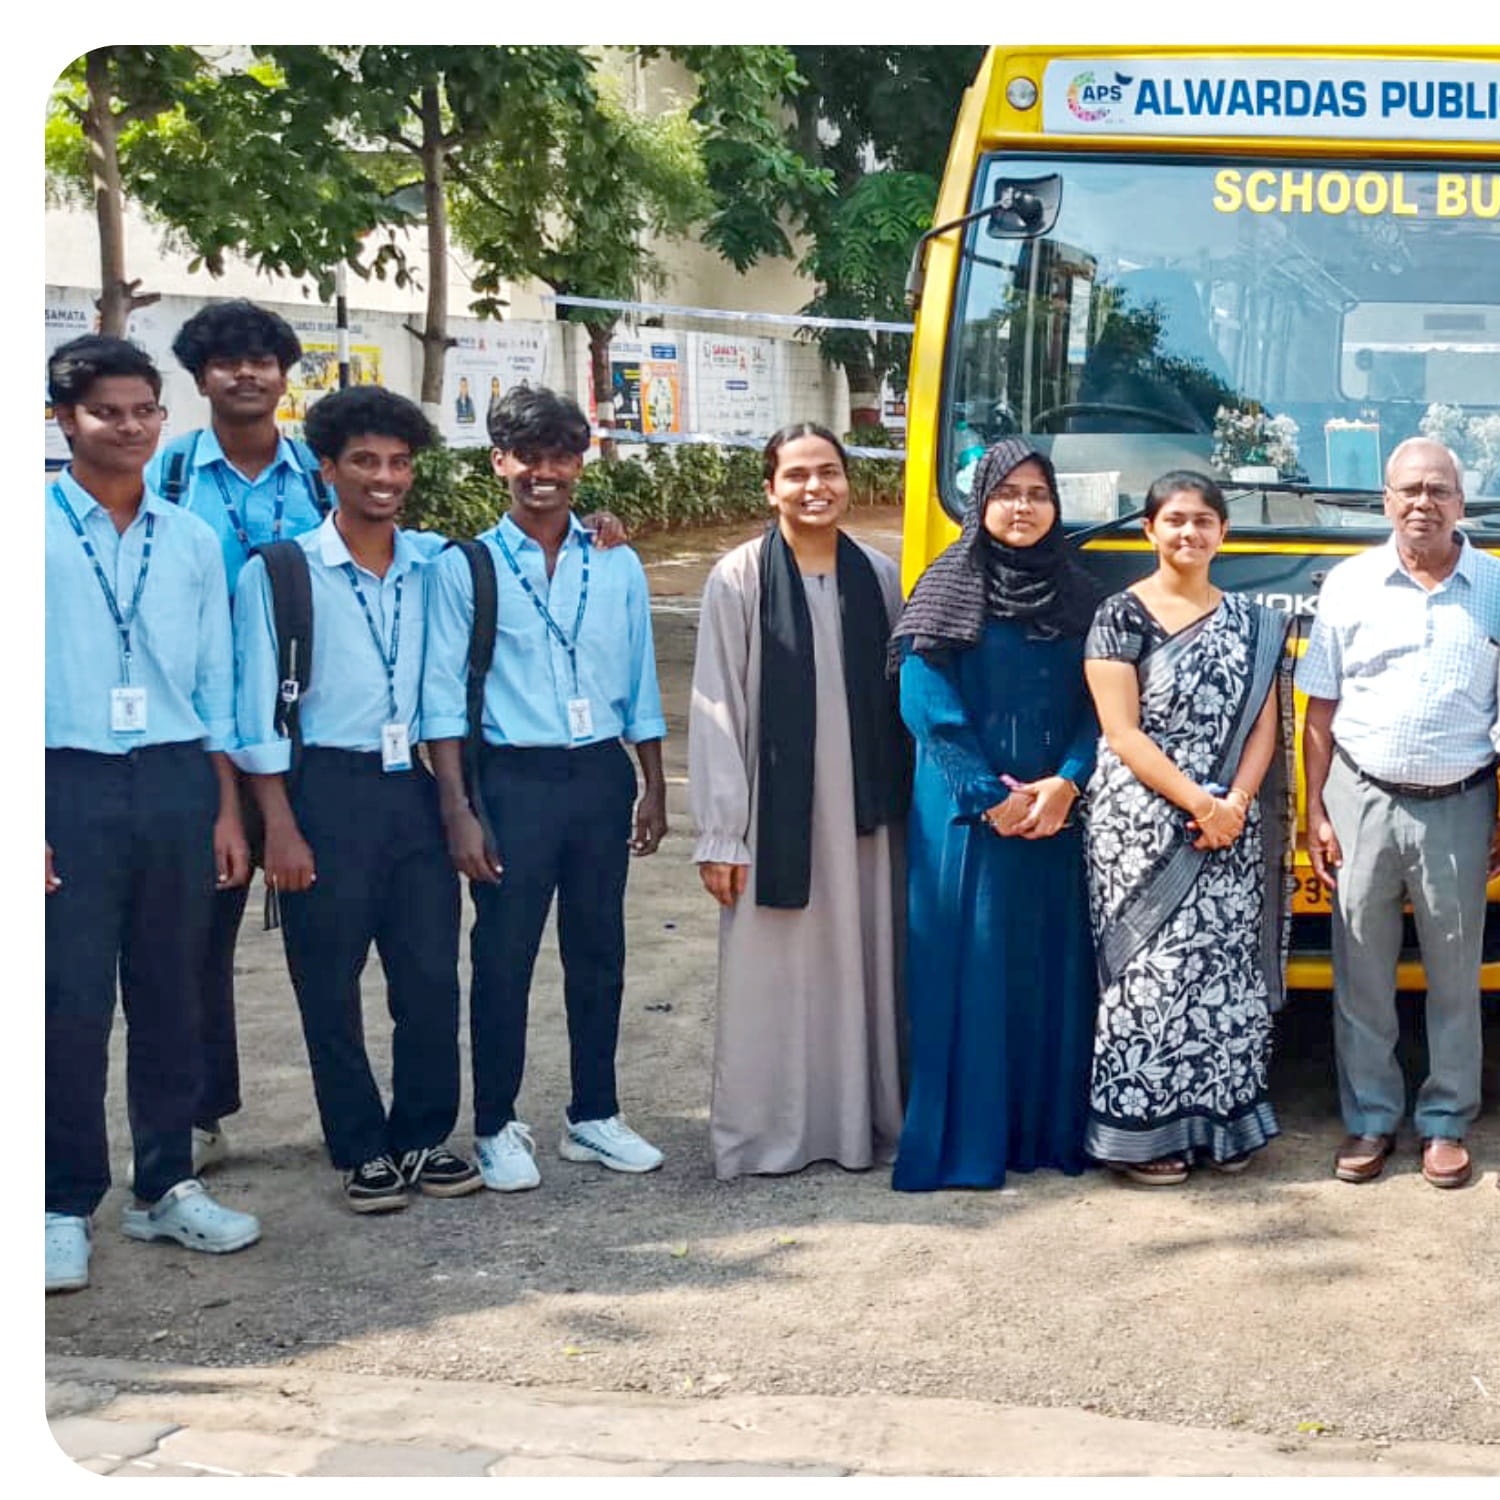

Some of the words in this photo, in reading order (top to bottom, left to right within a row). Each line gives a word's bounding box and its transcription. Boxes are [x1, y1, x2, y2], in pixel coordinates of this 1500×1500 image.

[1082, 85, 1122, 101] APS
[1134, 79, 1367, 118] ALWARDAS
[1212, 169, 1418, 215] SCHOOL
